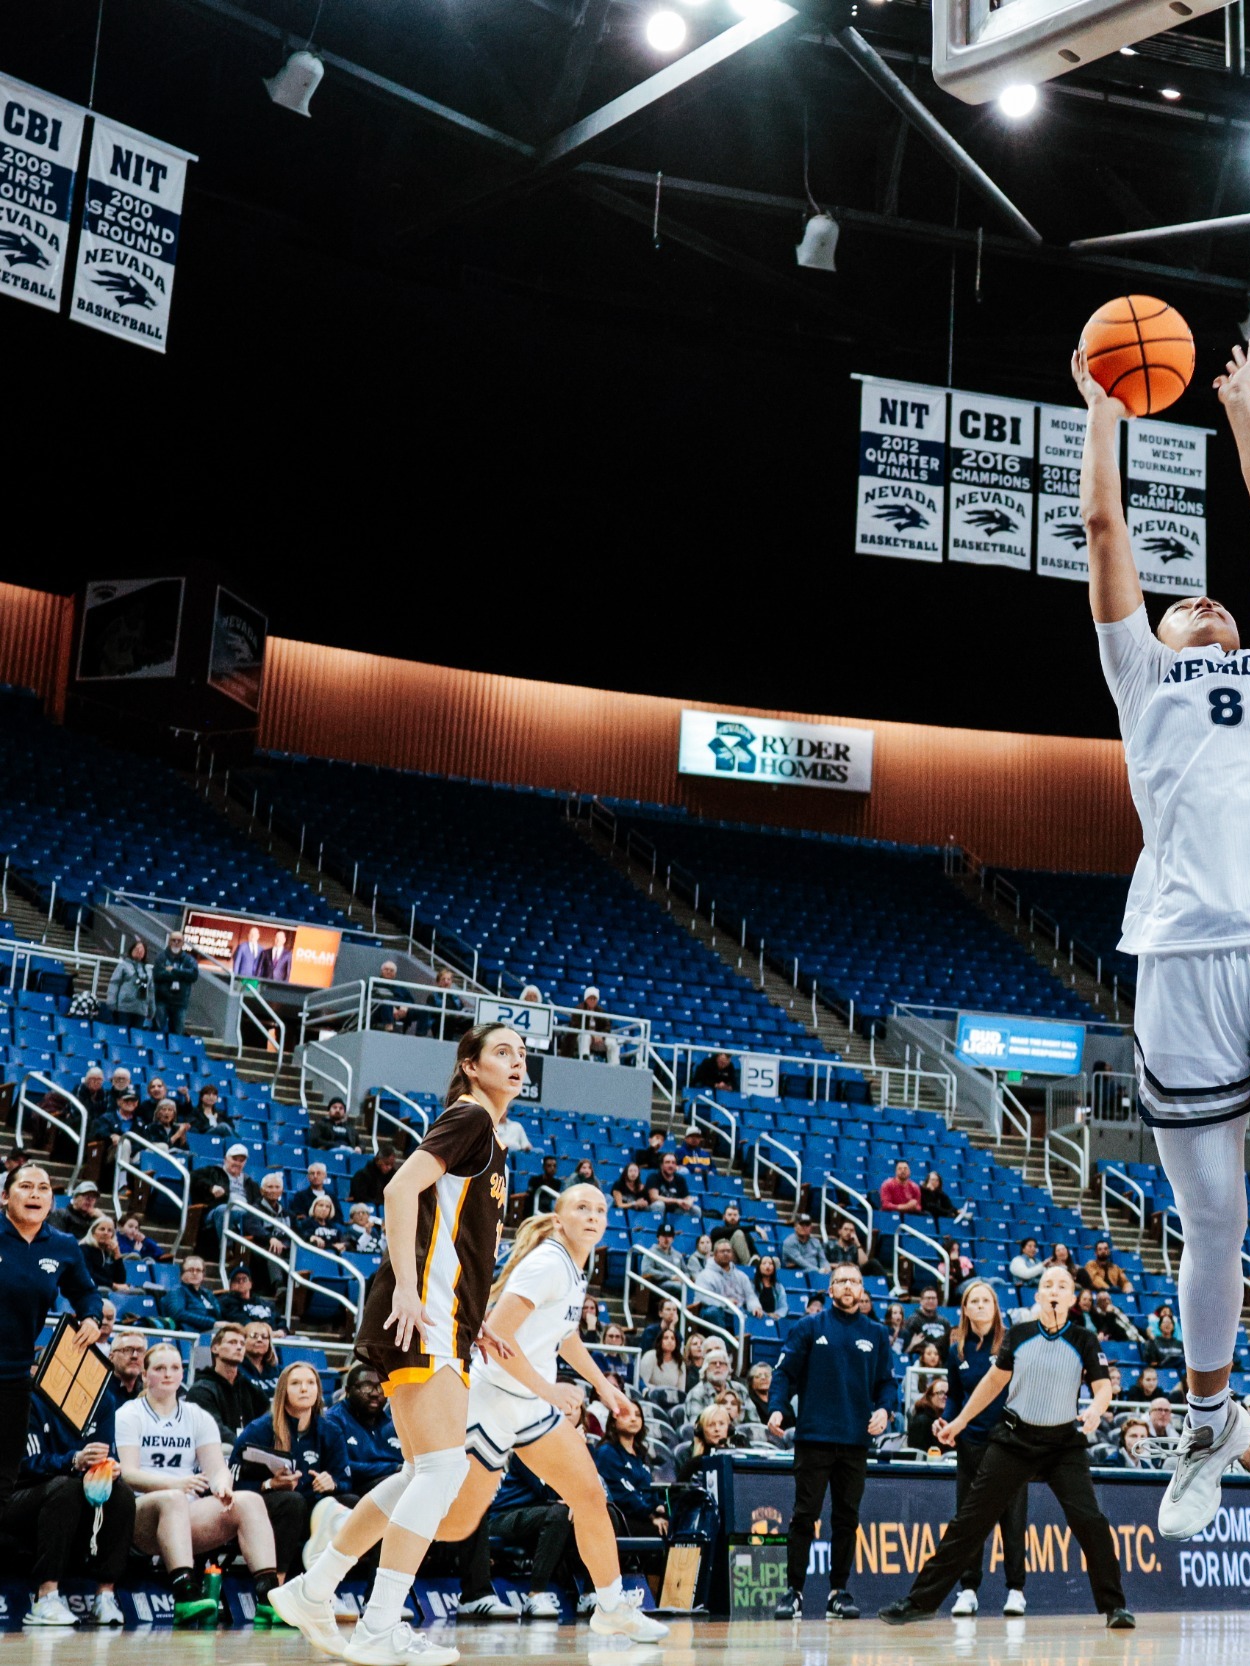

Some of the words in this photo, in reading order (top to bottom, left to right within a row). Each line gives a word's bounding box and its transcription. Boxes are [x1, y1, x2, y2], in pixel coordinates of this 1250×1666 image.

[3, 101, 62, 152] CBI
[2, 147, 52, 177] 2009
[110, 144, 167, 193] NIT
[0, 183, 58, 215] OUND
[110, 190, 153, 219] 2010
[88, 199, 175, 244] SECOND
[97, 219, 163, 257] ROUND
[84, 248, 166, 295] NEVADA
[77, 297, 163, 340] BASKETBALL
[879, 397, 930, 429] NIT
[959, 409, 1022, 446] CBI
[881, 436, 919, 453] 2012
[1138, 433, 1196, 449] MOUNTAIN
[865, 448, 940, 471] QUARTER
[961, 449, 1020, 473] 2016
[1151, 449, 1183, 461] WEST
[877, 464, 928, 481] FINALS
[952, 468, 1031, 489] CHAMPIONS
[1131, 460, 1202, 478] TOURNAMENT
[864, 485, 937, 513] NEVADA
[1148, 483, 1186, 498] 2017
[955, 491, 1026, 519] NEVADA
[1130, 494, 1204, 515] CHAMPIONS
[861, 534, 938, 551] BASKETBALL
[1132, 519, 1201, 545] NEVADA
[953, 537, 1026, 557] BASKETBALL
[1138, 571, 1203, 588] ASKETBALL
[1208, 686, 1244, 727] 8
[762, 735, 851, 762] RYDER
[760, 757, 848, 783] HOMES
[185, 925, 233, 941] EXPERIENCE
[200, 936, 229, 948] DOLAN
[296, 948, 335, 962] DOLAN
[497, 1006, 531, 1030] 24
[962, 1040, 1006, 1056] LIGHT
[969, 1029, 1002, 1043] BUD
[747, 1068, 774, 1088] 25
[142, 1435, 191, 1448] NEVADA
[1180, 1551, 1221, 1587] FOR
